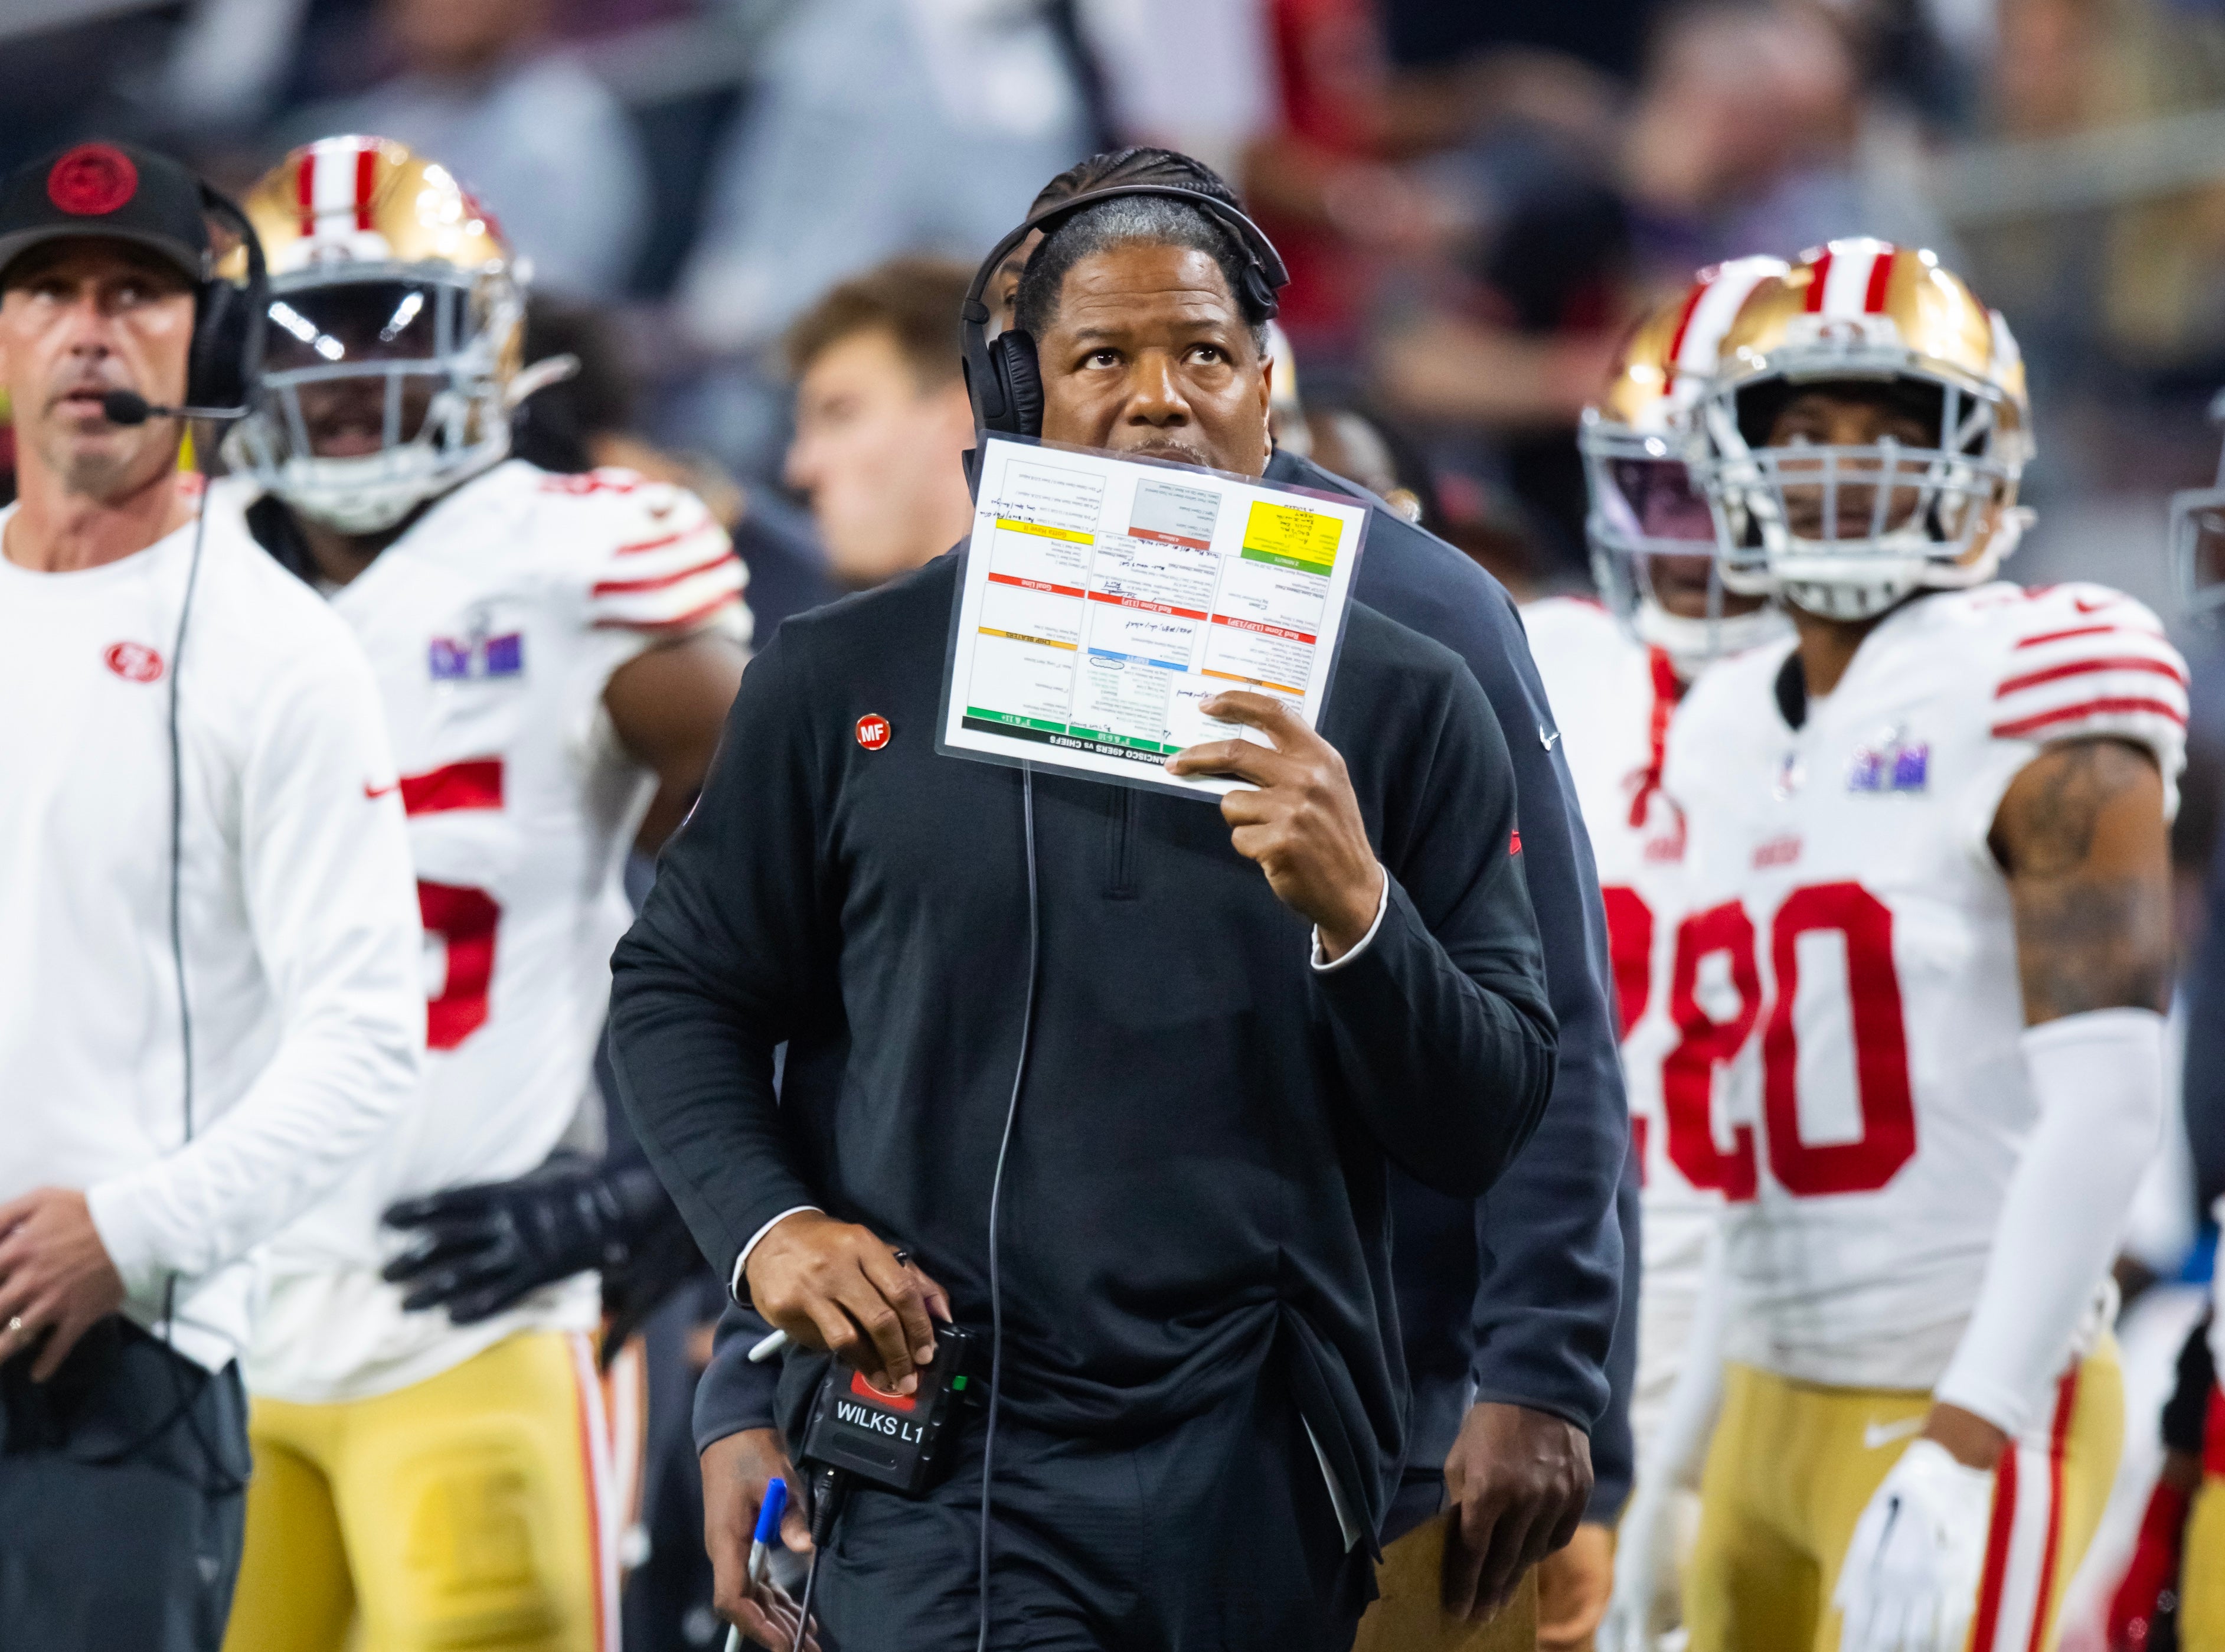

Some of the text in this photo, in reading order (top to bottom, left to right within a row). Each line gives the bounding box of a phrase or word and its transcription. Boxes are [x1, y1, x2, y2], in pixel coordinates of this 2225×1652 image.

[1030, 525, 1047, 534] Have
[1047, 528, 1067, 538] Gotta
[1274, 556, 1295, 565] MINUTE
[1021, 579, 1052, 591] Goal Line
[1120, 597, 1172, 613] Red Zone (11P)
[1227, 617, 1299, 639] Red Zone (12P/13P)
[1000, 714, 1014, 723] 11+
[861, 724, 884, 742] MF
[1097, 732, 1113, 742] 6-10
[1048, 734, 1082, 748] CHIEFS
[1095, 743, 1124, 756] 49ERS
[838, 1400, 923, 1444] WILKS L1
